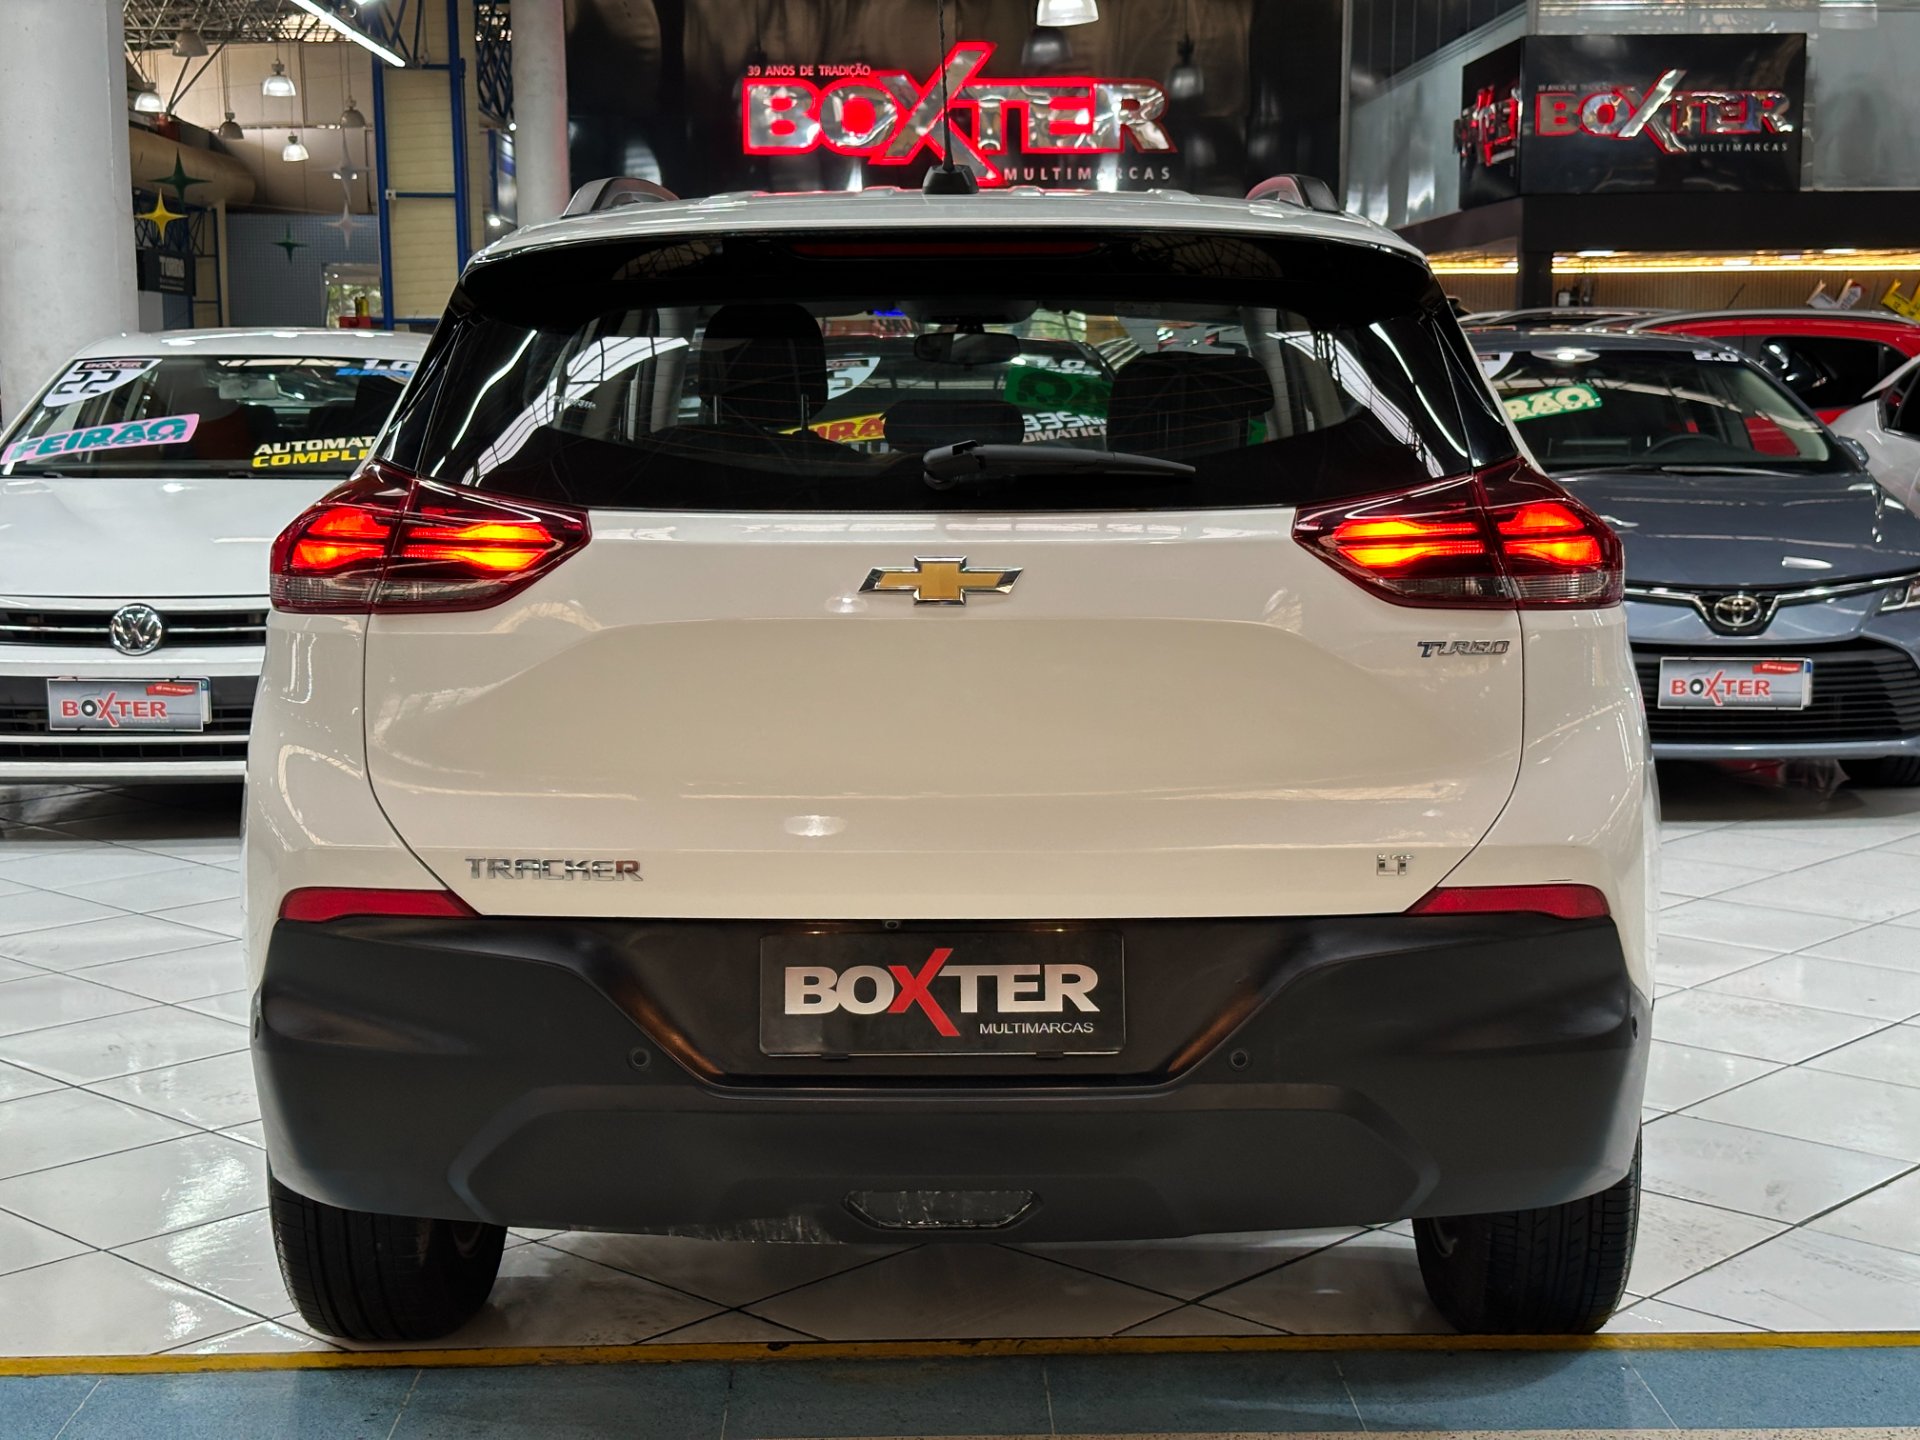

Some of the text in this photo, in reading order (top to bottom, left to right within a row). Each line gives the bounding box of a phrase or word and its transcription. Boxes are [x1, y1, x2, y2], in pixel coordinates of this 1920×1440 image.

[747, 63, 871, 78] 39 ANOS DE TRADIÇÃO
[743, 42, 1177, 185] BOXTER
[1535, 68, 1795, 154] BOXTER
[1688, 142, 1788, 153] MULTIMARCAS
[1691, 350, 1740, 363] 2.0
[53, 369, 122, 396] 22
[254, 435, 378, 457] AUTOMAT
[252, 449, 372, 469] COMPL
[1417, 640, 1511, 659] TURBO
[1669, 669, 1772, 707] BOXTER
[60, 690, 169, 728] BOXTER
[464, 857, 644, 882] TRACKER
[1376, 854, 1415, 877] LT
[784, 947, 1101, 1038] BOXTER
[979, 1021, 1095, 1035] MULTIMARCAS
